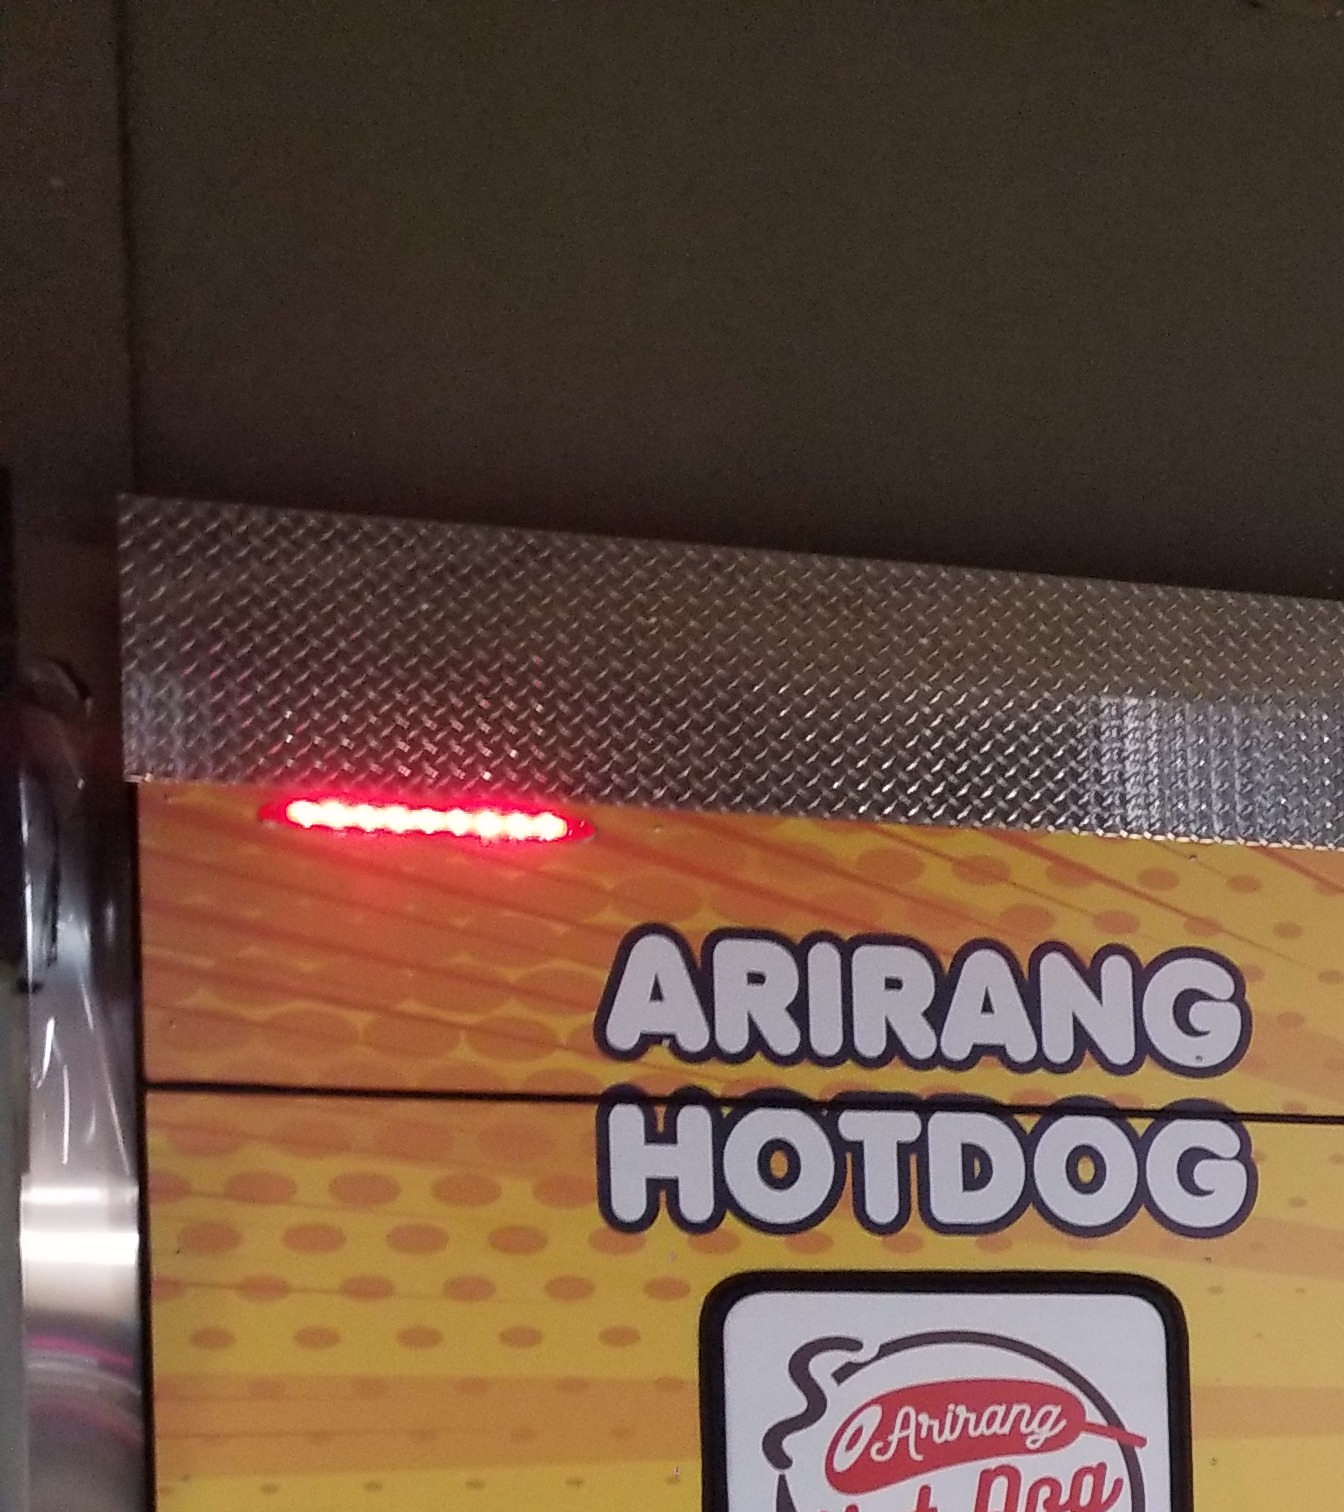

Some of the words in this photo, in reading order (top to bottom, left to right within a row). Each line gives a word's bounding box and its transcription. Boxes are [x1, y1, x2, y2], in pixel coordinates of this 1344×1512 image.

[596, 925, 1250, 1076] ARIRANG
[599, 1087, 1256, 1236] HOTDOG
[871, 1403, 1068, 1463] Arirang
